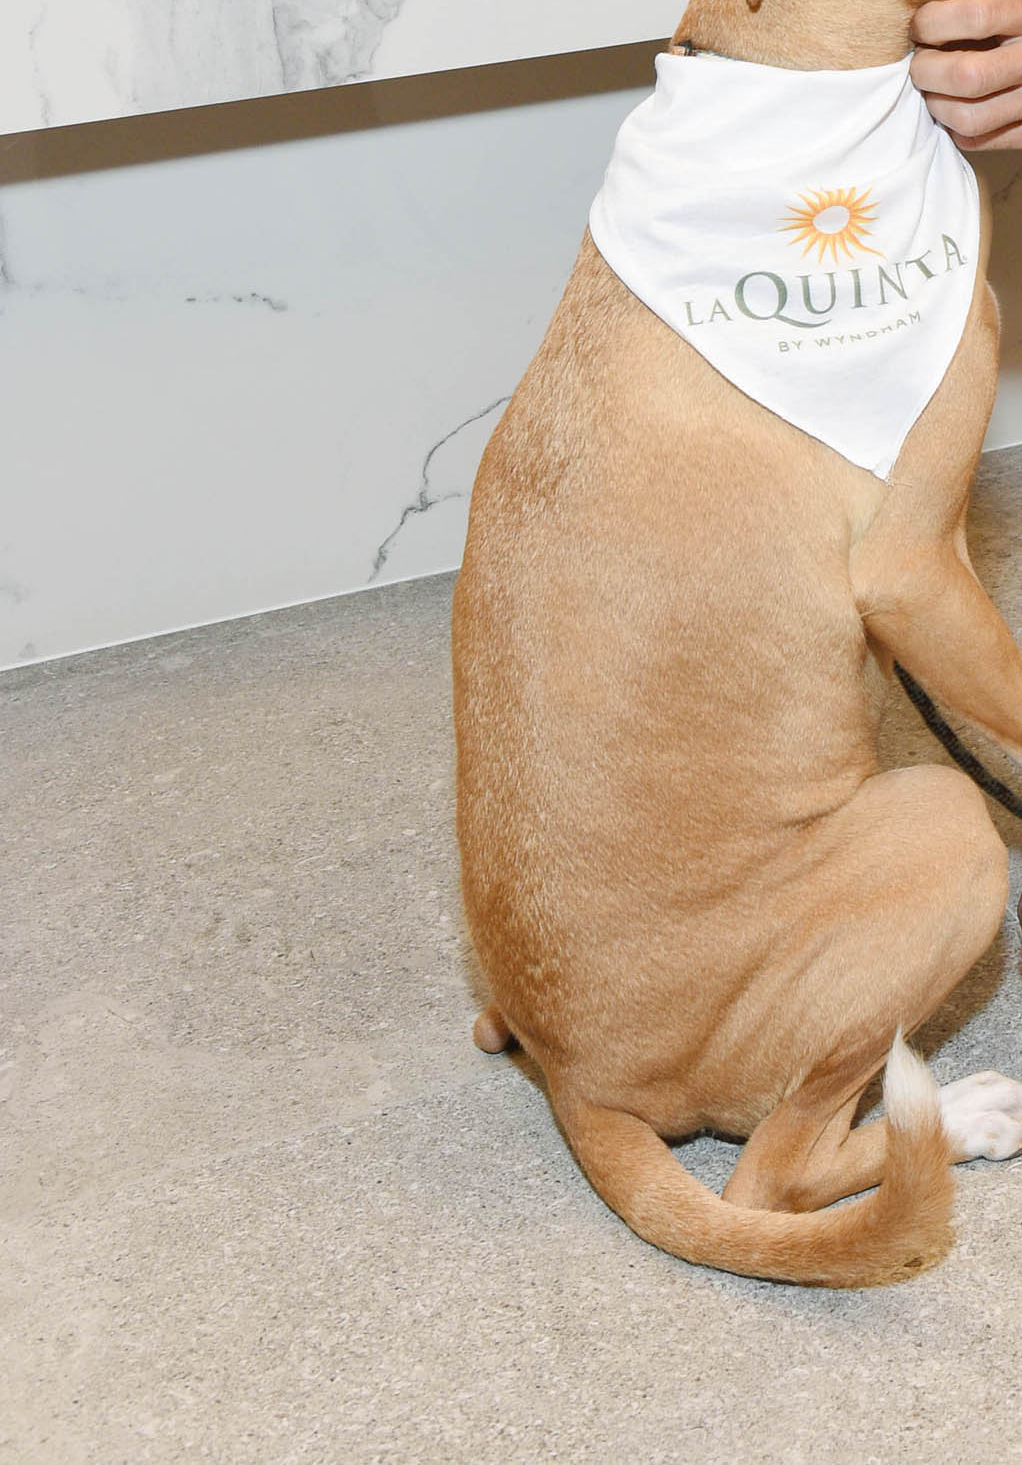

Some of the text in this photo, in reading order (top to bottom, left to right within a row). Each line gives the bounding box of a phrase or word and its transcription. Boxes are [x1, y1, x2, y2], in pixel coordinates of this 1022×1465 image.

[684, 233, 964, 329] LA QUINTA
[778, 311, 922, 352] BY WYNDHAM
